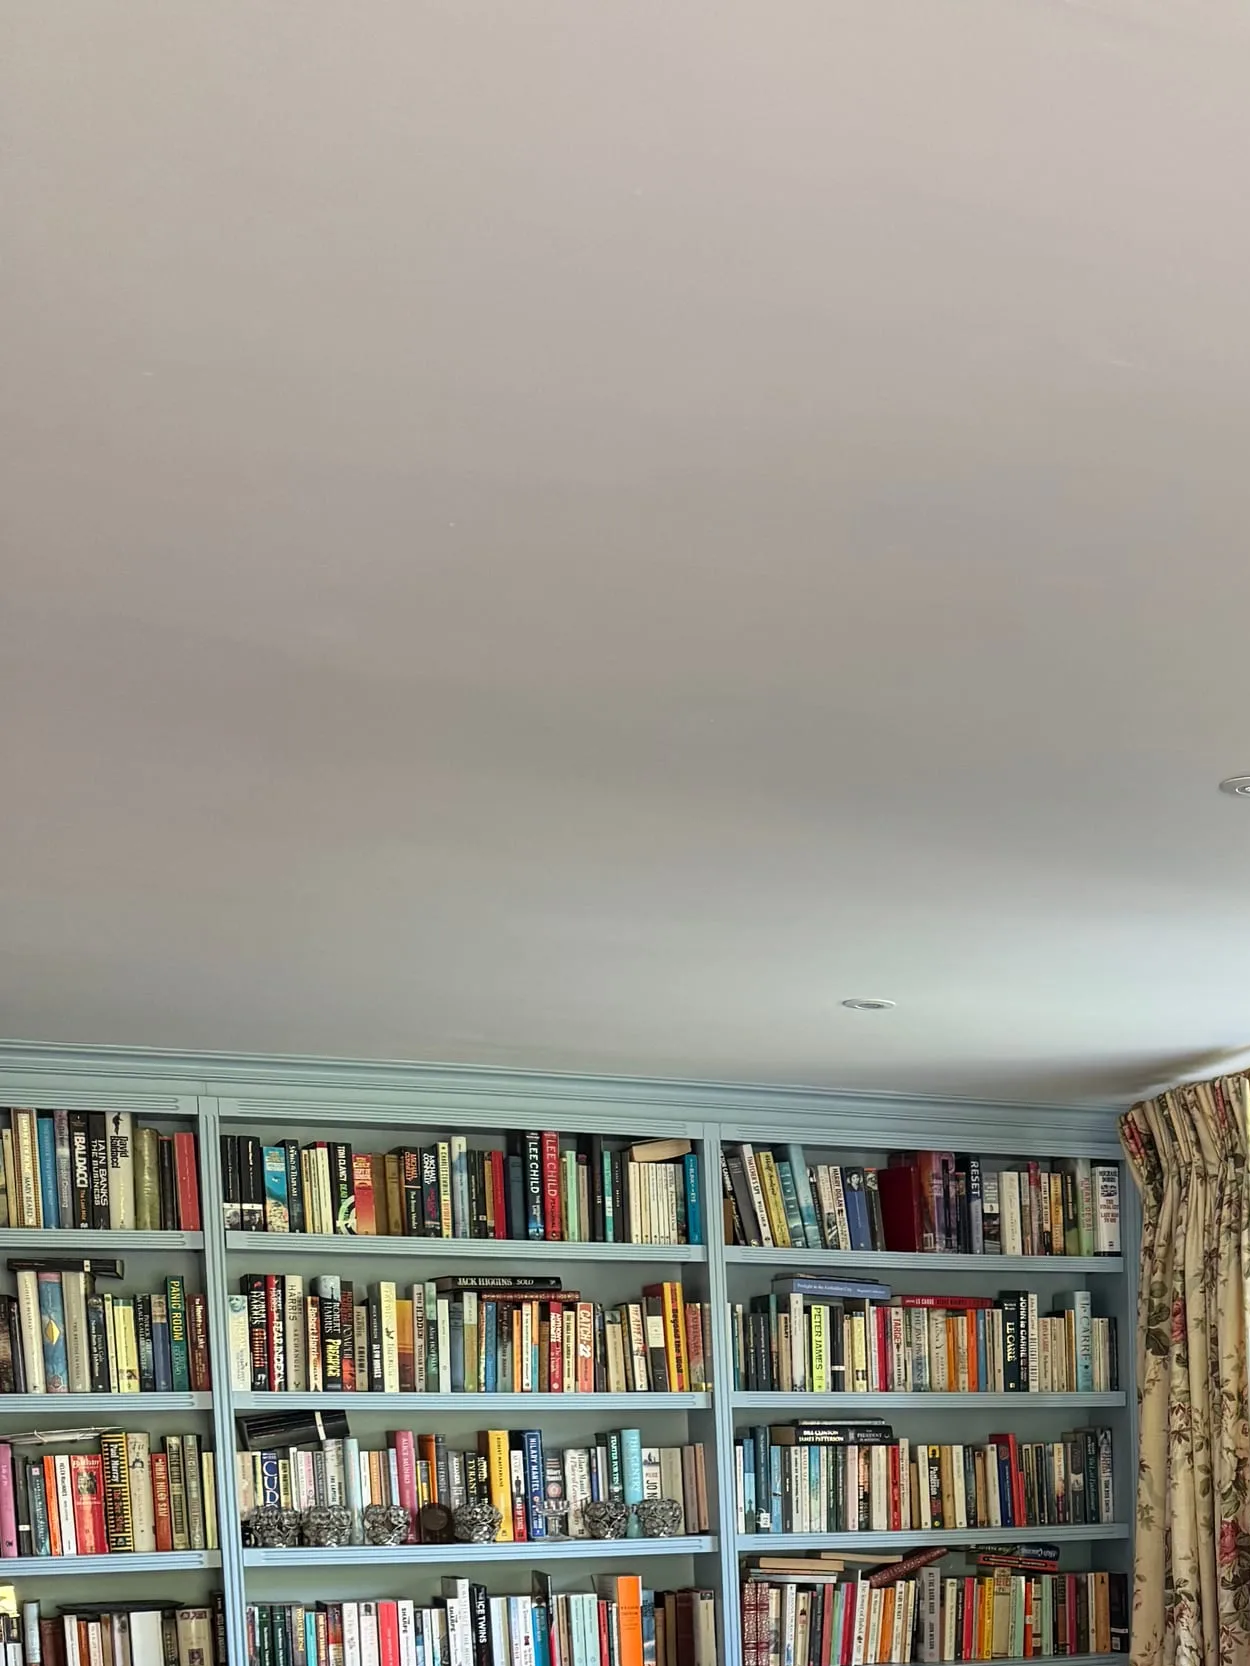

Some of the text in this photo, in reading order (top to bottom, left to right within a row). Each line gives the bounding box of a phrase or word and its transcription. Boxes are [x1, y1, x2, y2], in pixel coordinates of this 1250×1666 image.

[74, 1136, 88, 1187] BALDACCI
[110, 1136, 120, 1168] Baldacci
[119, 1136, 129, 1158] David
[337, 1146, 346, 1181] TOM CLANCY
[92, 1160, 100, 1206] BUSINESS
[98, 1140, 108, 1206] IAIN BANKS
[529, 1142, 540, 1193] LEE CHILD
[546, 1140, 558, 1197] LEE CHILD
[971, 1161, 980, 1197] RESET
[24, 1177, 34, 1217] MARY BEARD
[479, 1278, 512, 1286] HIGGINS
[170, 1280, 183, 1341] PANIC ROOM
[288, 1285, 297, 1321] HARRIS
[309, 1307, 318, 1334] Robert
[324, 1302, 333, 1333] HARRIS
[273, 1321, 284, 1344] FEAR
[579, 1310, 592, 1358] CATCH-22
[670, 1308, 680, 1338] Beyond
[814, 1307, 823, 1370] PETER JAMES
[893, 1319, 902, 1344] TARGET
[1006, 1322, 1015, 1334] LE
[197, 1335, 205, 1349] Lake
[325, 1339, 341, 1377] PRECIPICE
[358, 1346, 366, 1374] ENIGMA
[110, 1444, 121, 1482] Paul Murray
[155, 1462, 165, 1479] WHAT
[468, 1459, 477, 1495] TYRANT
[529, 1438, 540, 1492] HILARY MANTEL
[577, 1454, 585, 1472] Hilary
[630, 1436, 641, 1492] THE GENTRY
[930, 1466, 939, 1495] Patterson
[158, 1503, 168, 1517] SAW
[477, 1601, 487, 1643] ICE TWINS
